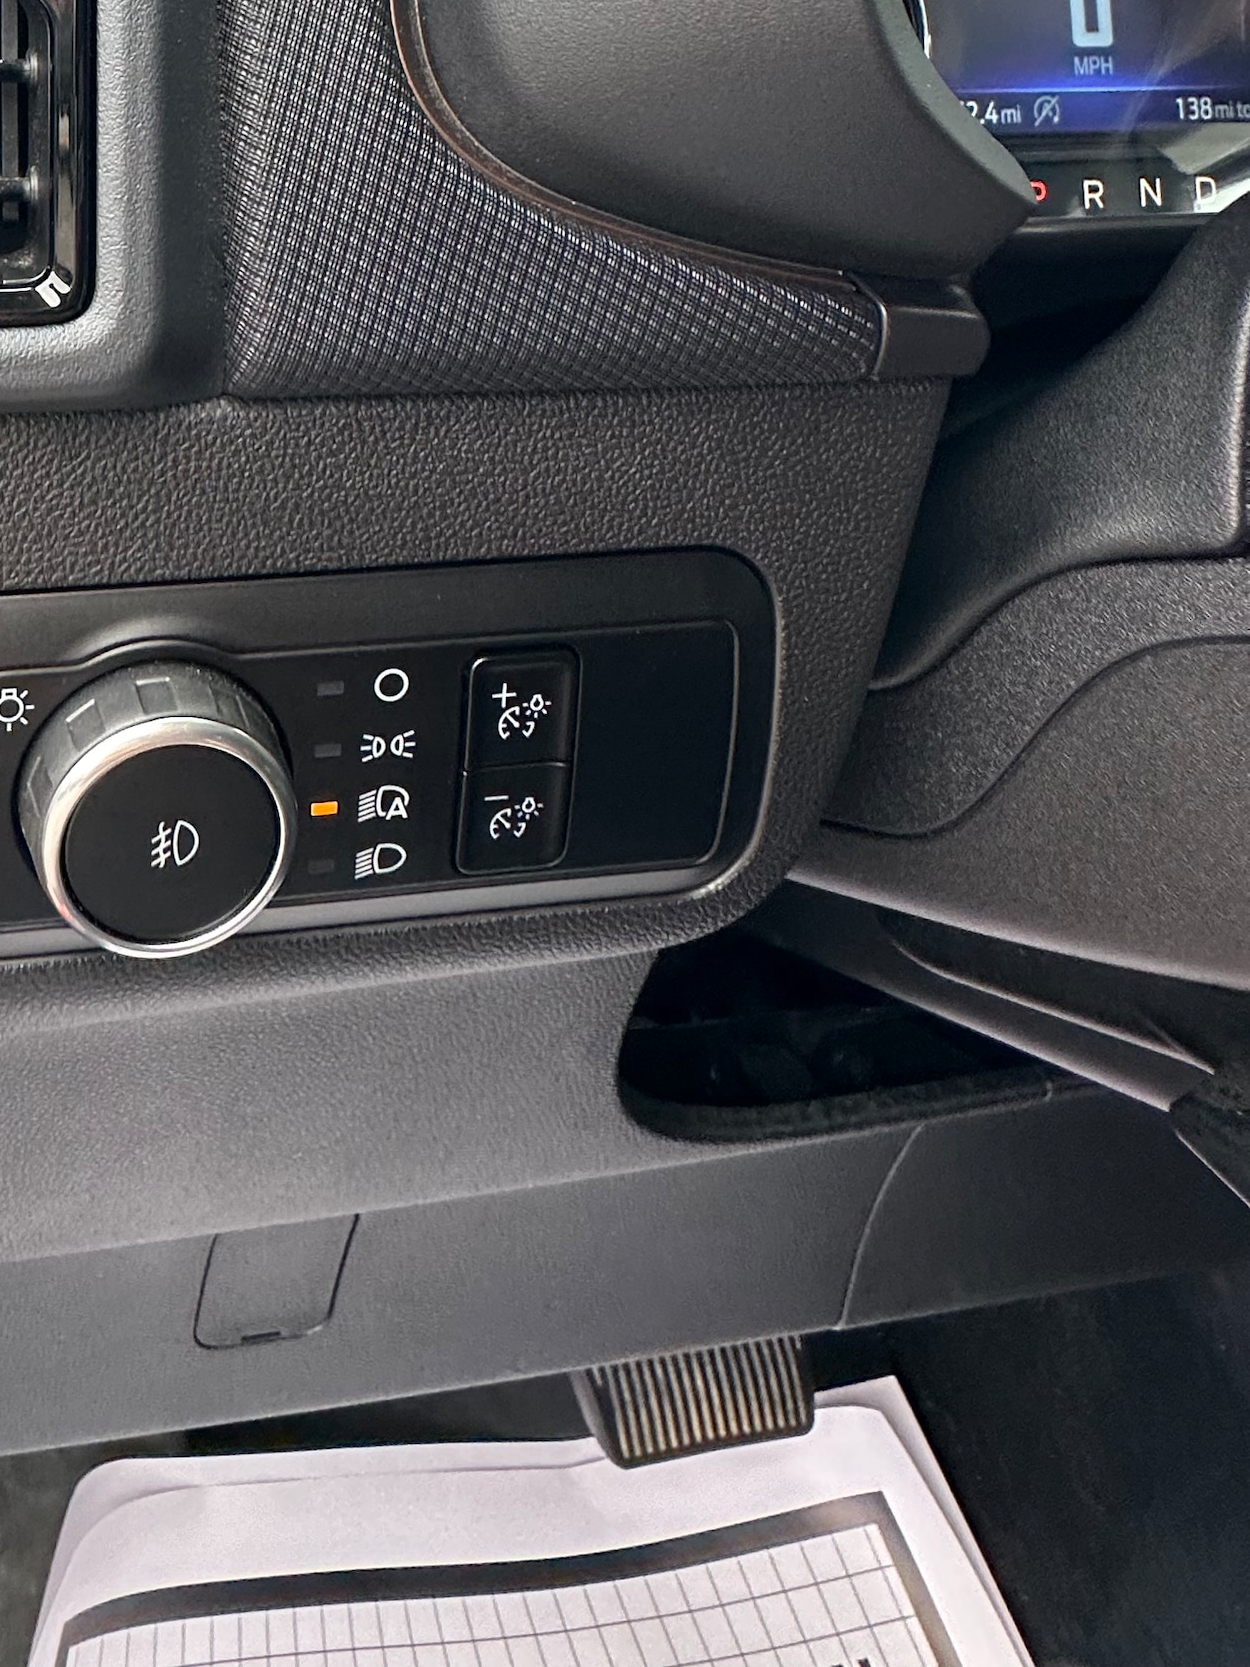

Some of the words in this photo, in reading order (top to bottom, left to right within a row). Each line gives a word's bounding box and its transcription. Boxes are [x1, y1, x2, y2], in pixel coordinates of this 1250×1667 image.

[1073, 55, 1114, 76] MPH
[959, 99, 998, 124] 2.4
[1000, 103, 1022, 124] mi
[1176, 96, 1212, 120] 138
[1082, 179, 1104, 209] R
[1139, 177, 1162, 207] N
[1195, 176, 1217, 205] D
